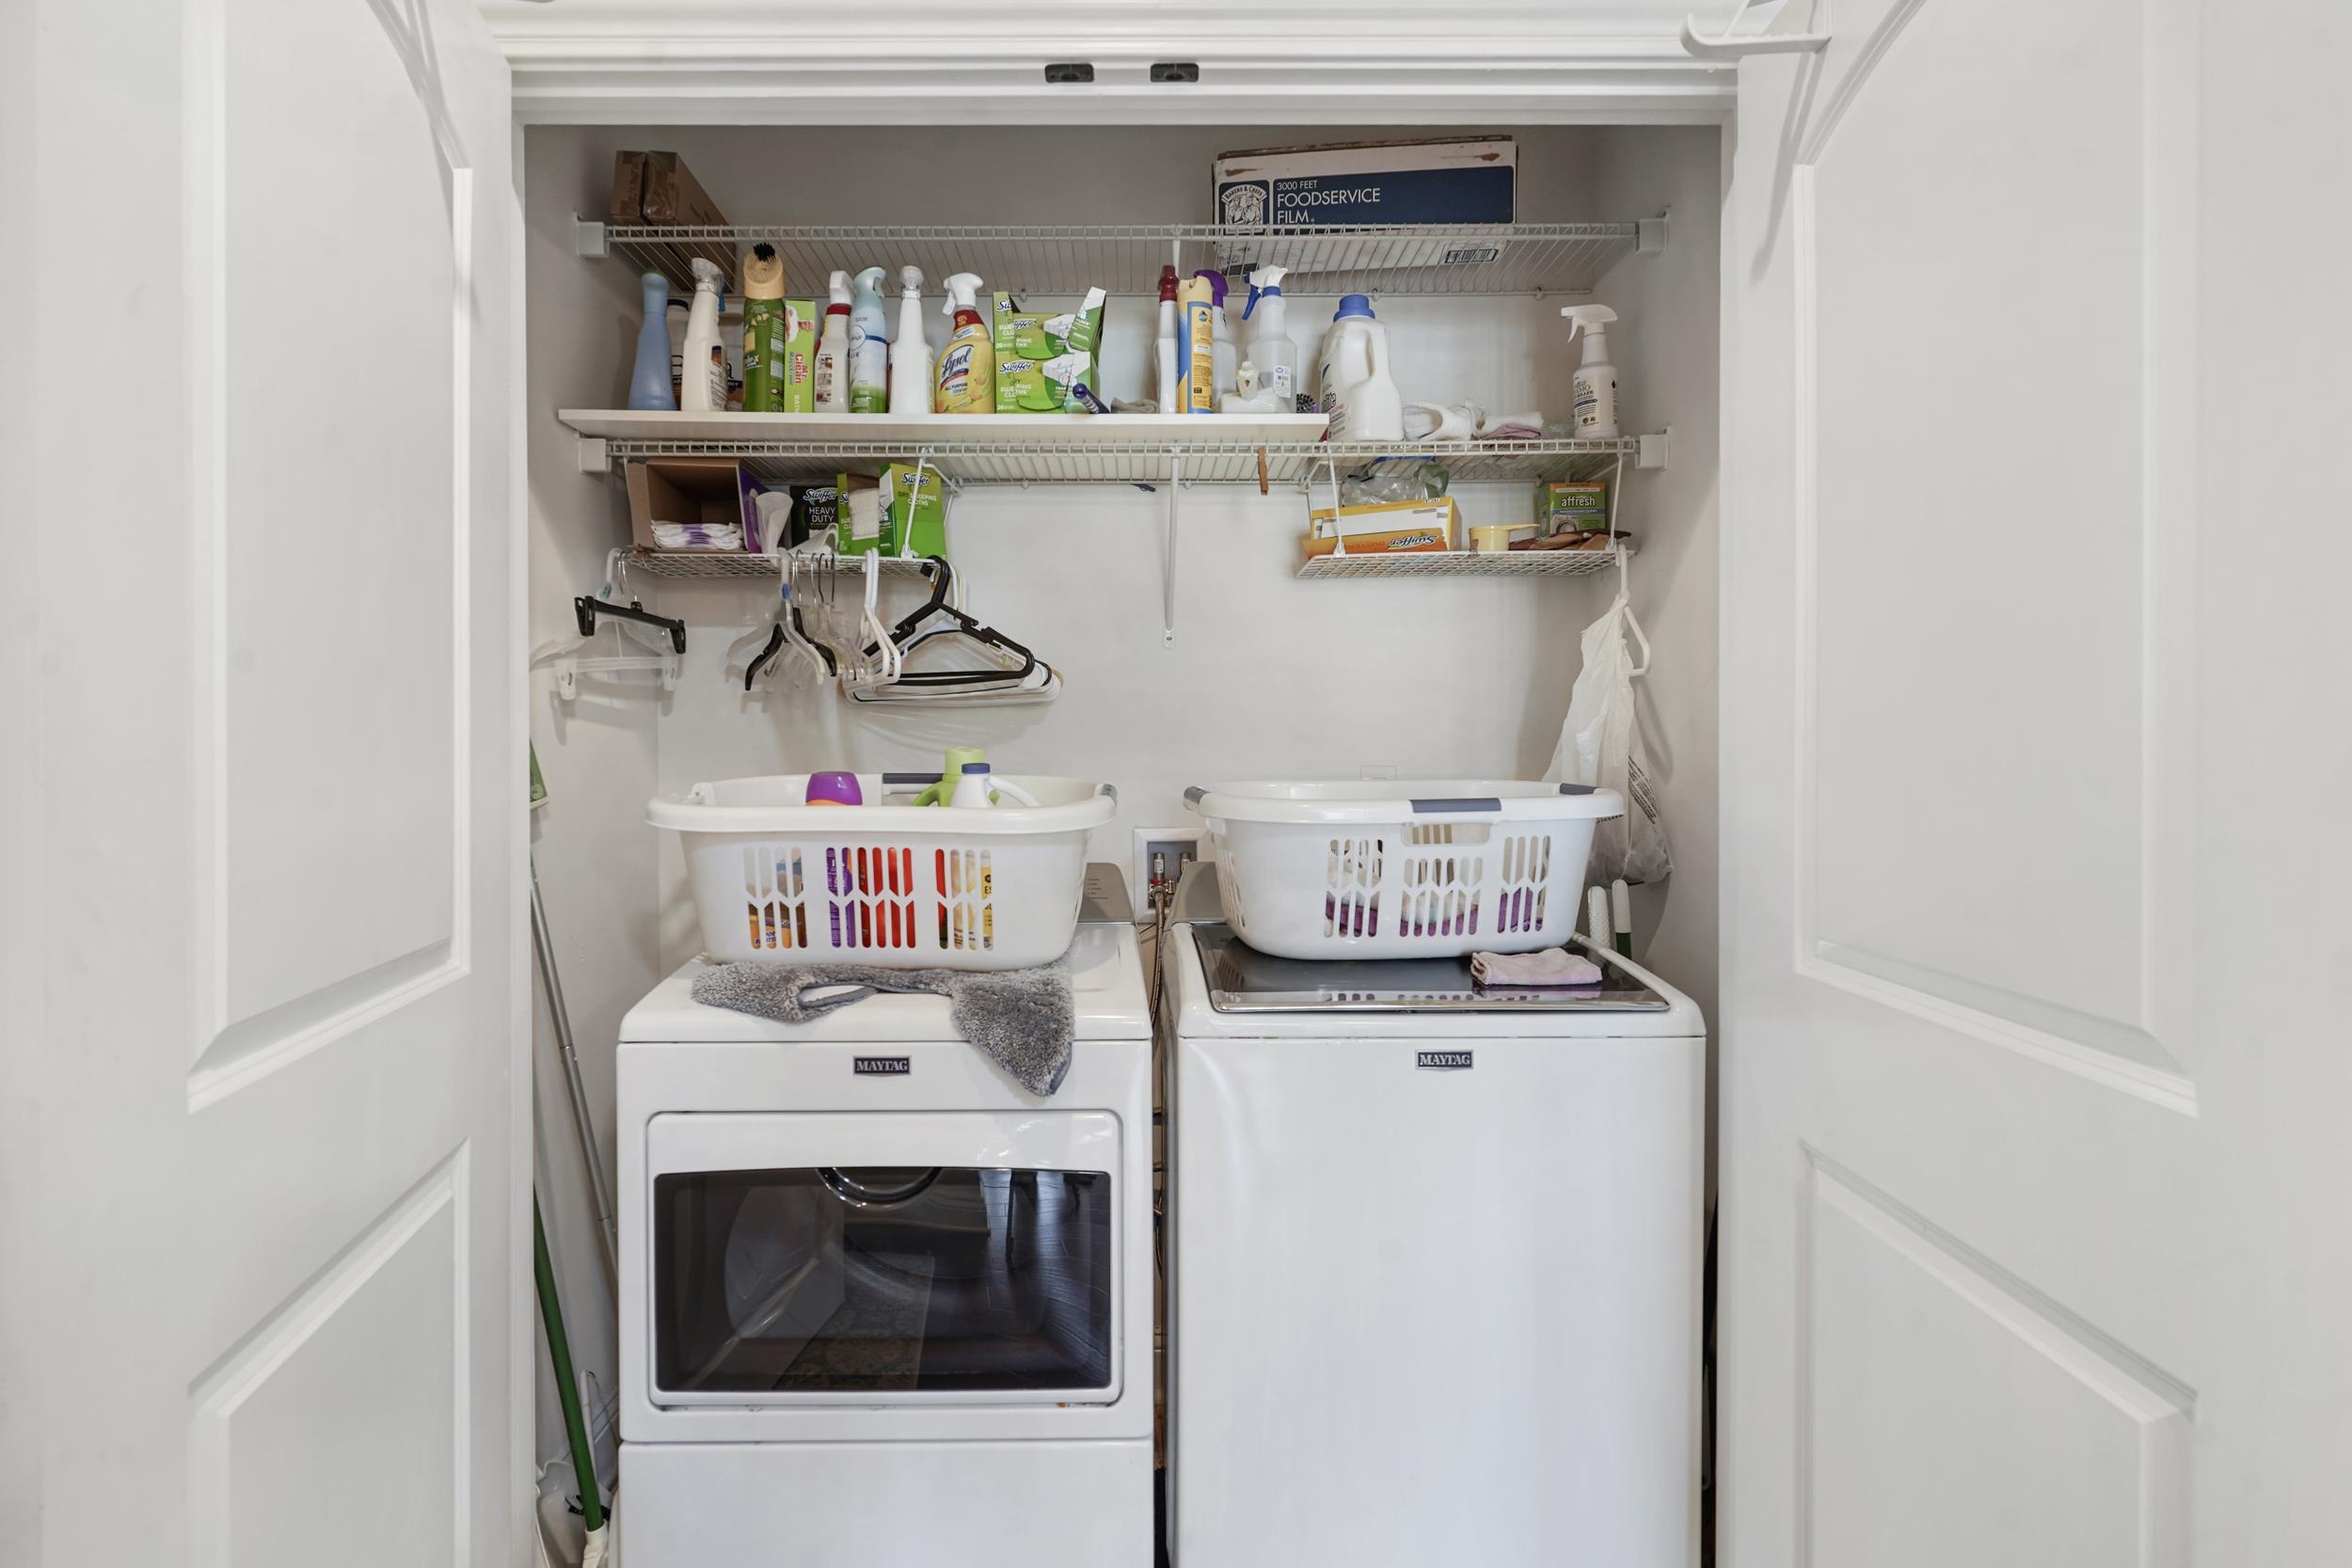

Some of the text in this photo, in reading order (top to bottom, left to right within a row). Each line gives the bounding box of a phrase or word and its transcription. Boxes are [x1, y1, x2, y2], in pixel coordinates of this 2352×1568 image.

[1277, 180, 1318, 191] 3000 FEET
[1277, 188, 1381, 207] FOODSERVICE
[1277, 210, 1309, 224] FILM
[941, 346, 972, 378] Lysol
[998, 361, 1033, 373] Swiffer
[803, 488, 836, 502] Swiffer
[1561, 495, 1596, 507] affresh
[809, 506, 836, 515] HEAVY
[811, 515, 834, 523] DUTY
[1389, 533, 1438, 548] Swiffer
[856, 1060, 908, 1071] MAYTAG
[1420, 1054, 1471, 1066] MAYTAG
